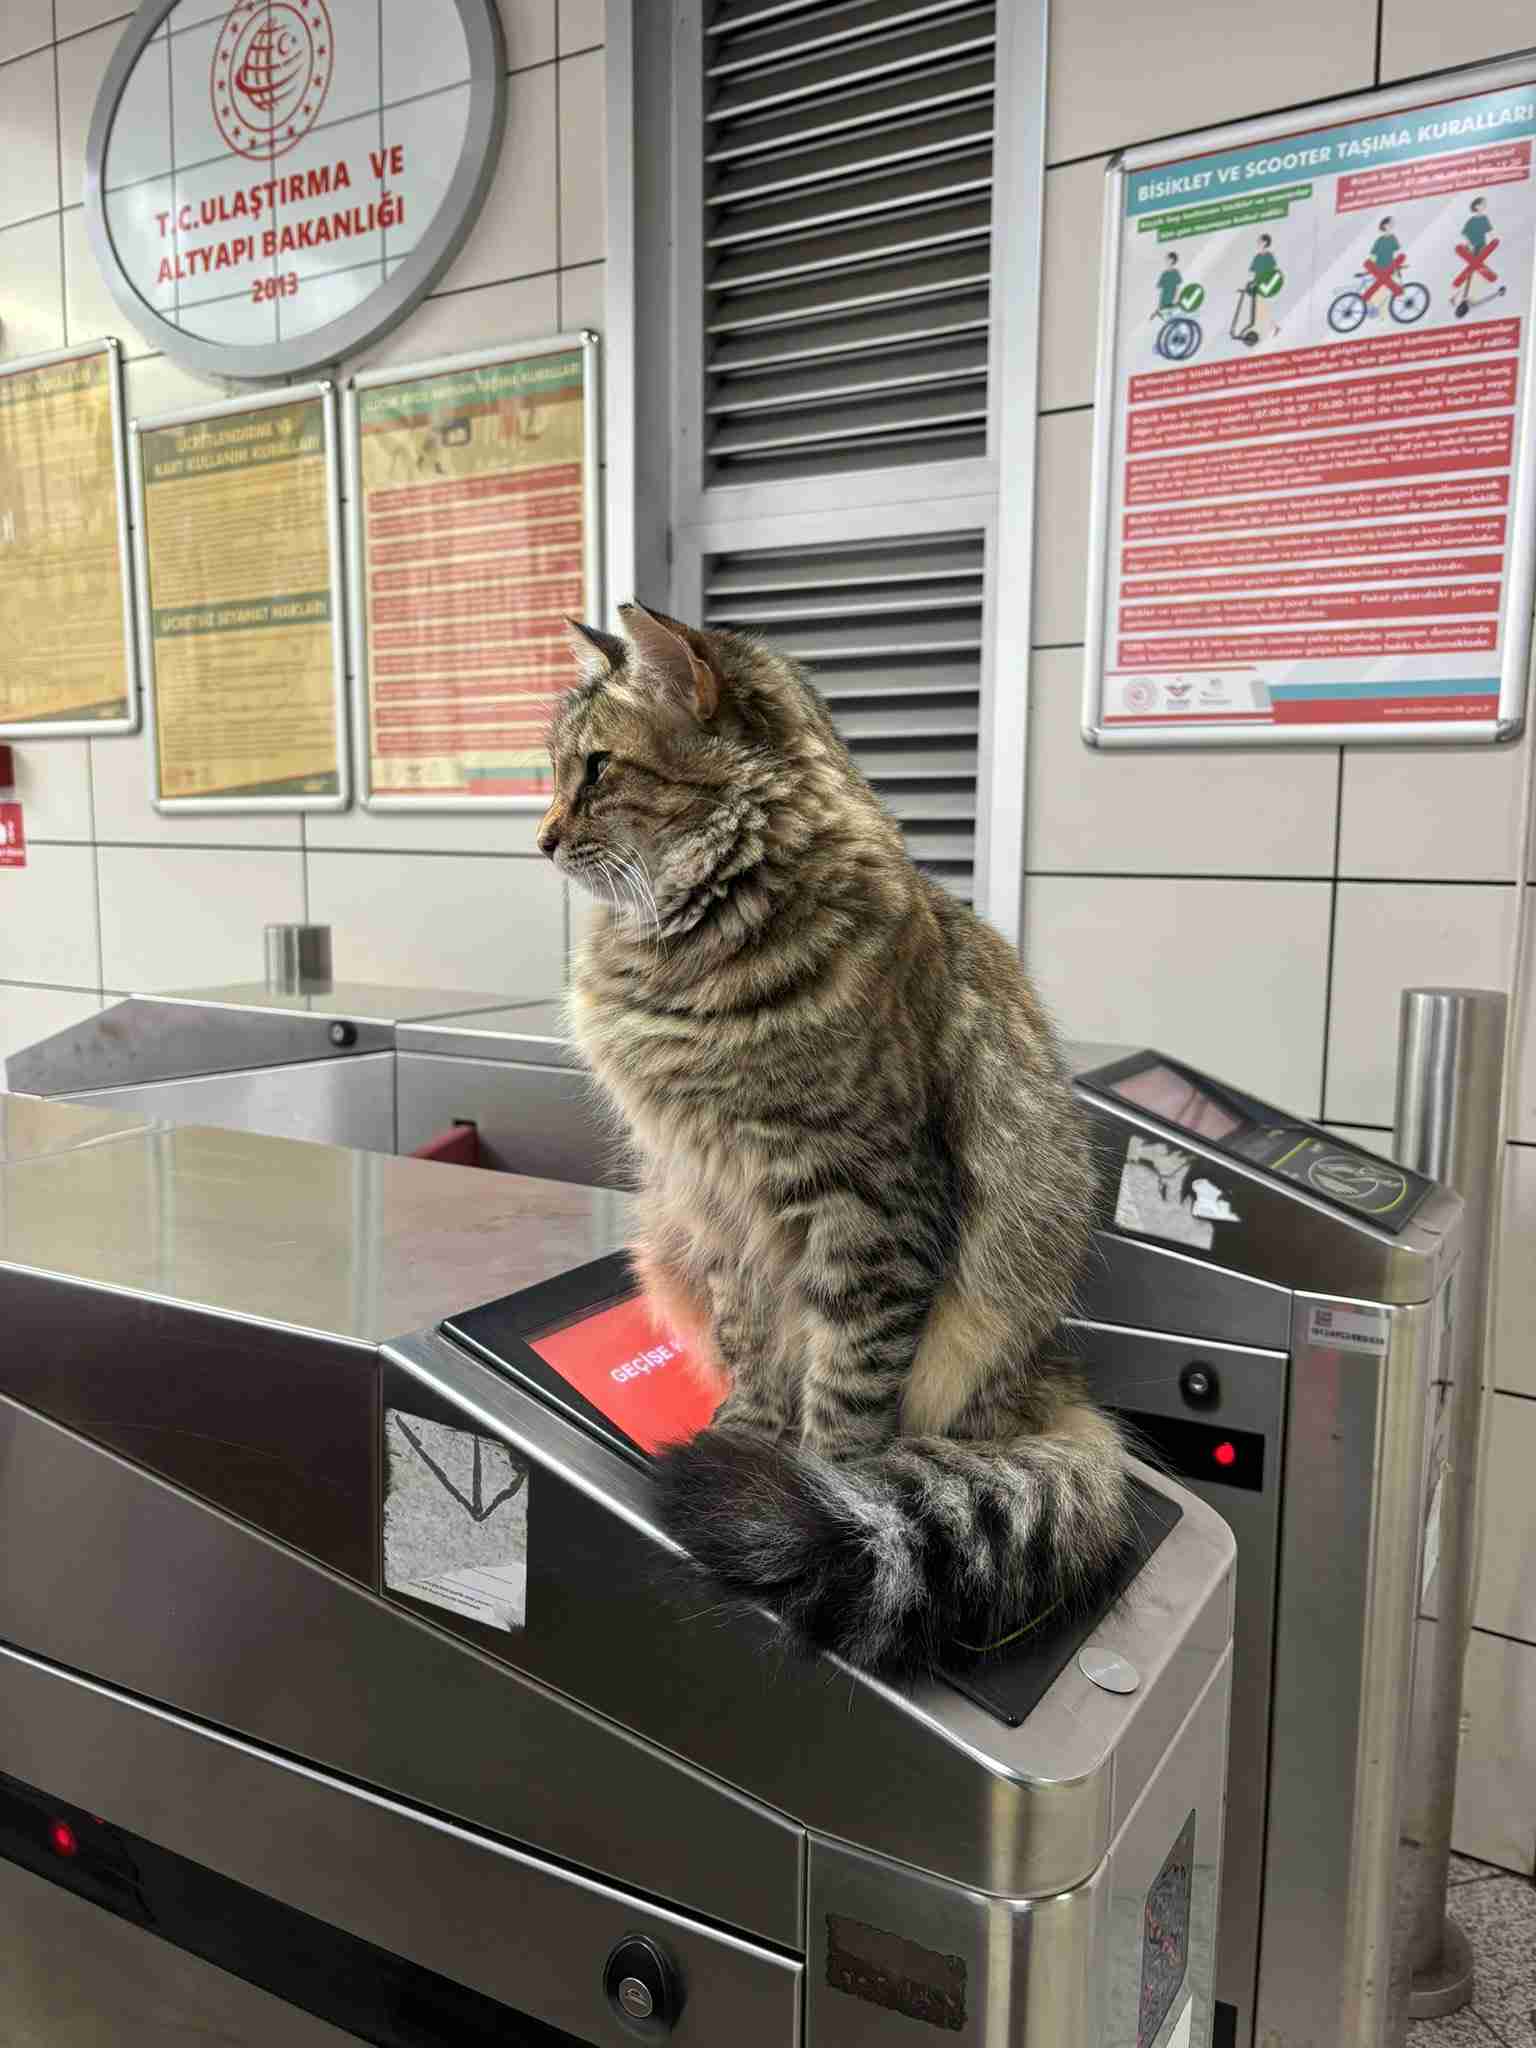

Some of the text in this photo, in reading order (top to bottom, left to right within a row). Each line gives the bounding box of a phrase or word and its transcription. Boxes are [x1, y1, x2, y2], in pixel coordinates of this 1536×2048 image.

[369, 145, 404, 179] VE
[1137, 104, 1534, 201] BİSİKLET VE SCOOTER TAŞIMA KURALLARI
[156, 191, 404, 284] ALTYAPI BAKANLIĞI
[252, 272, 298, 303] 2013
[610, 1344, 675, 1384] GEÇİŞE
